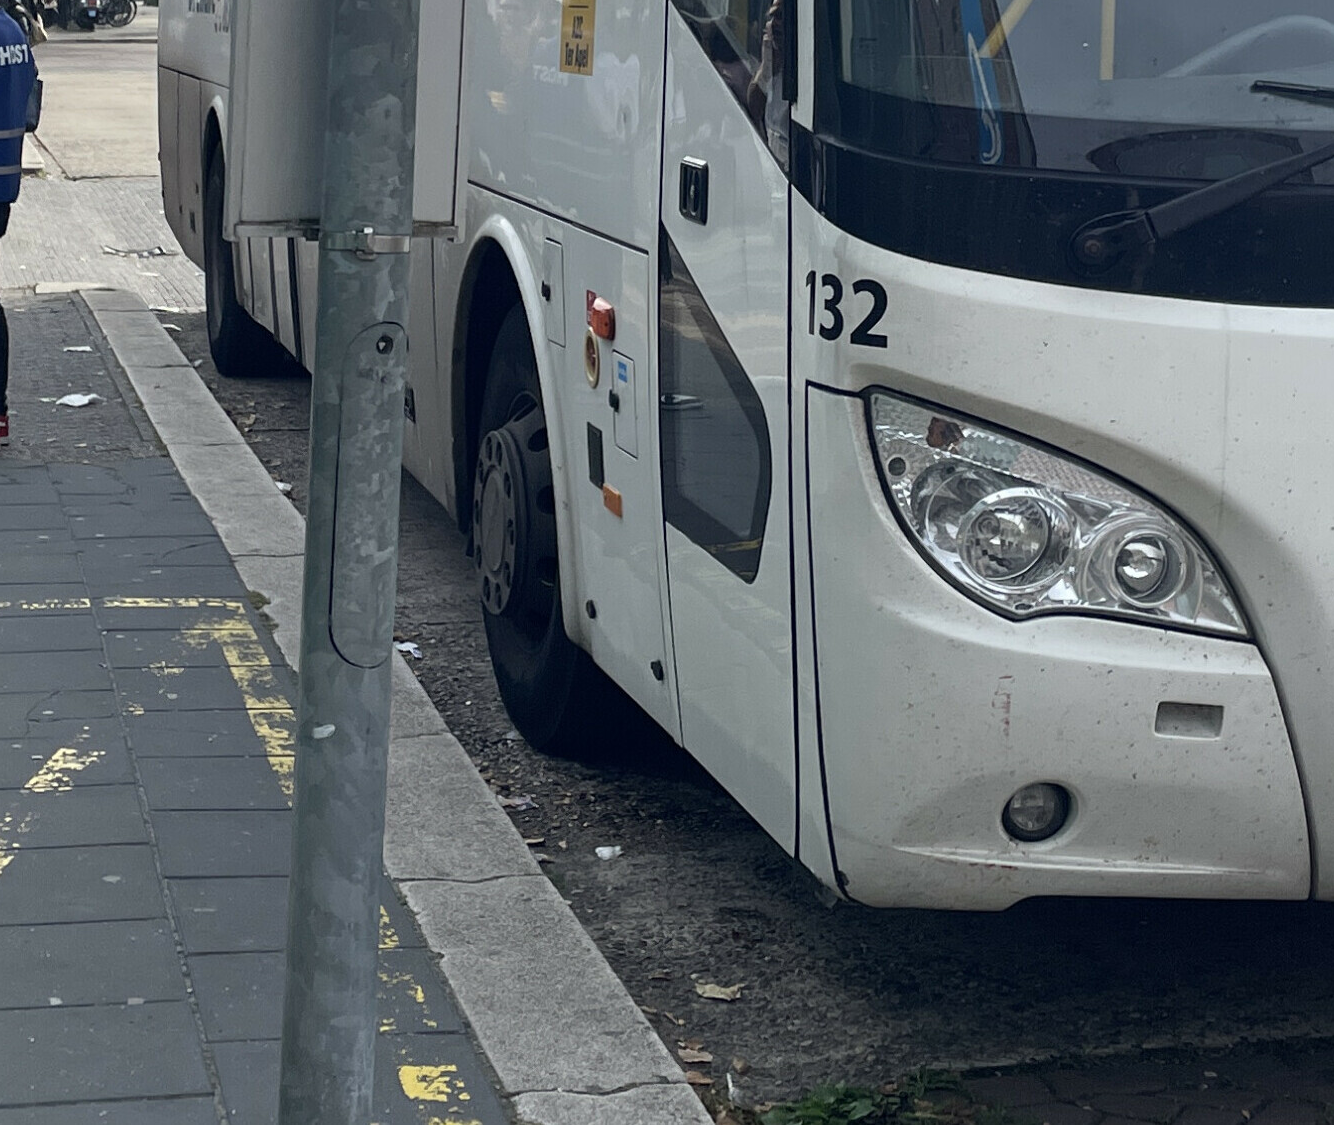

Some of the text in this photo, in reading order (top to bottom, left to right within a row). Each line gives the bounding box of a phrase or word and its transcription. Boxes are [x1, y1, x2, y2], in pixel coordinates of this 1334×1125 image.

[564, 41, 590, 73] Ter Apel
[805, 269, 889, 349] 132
